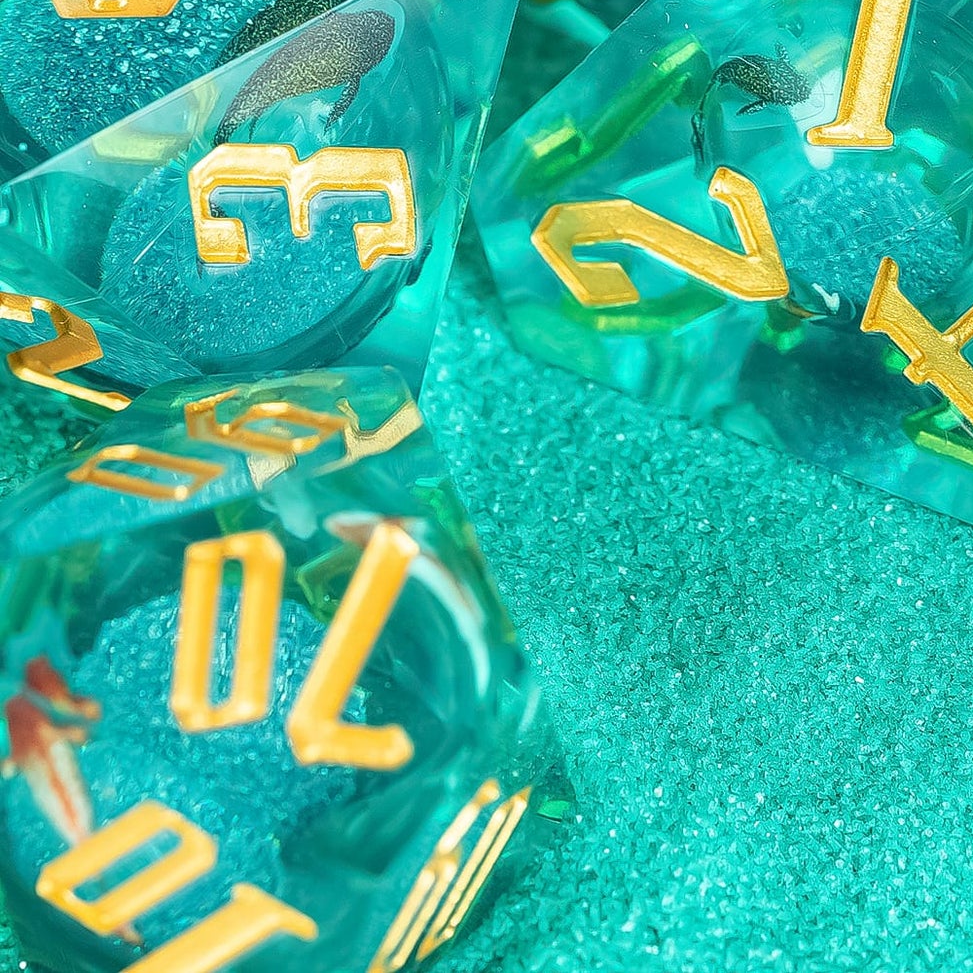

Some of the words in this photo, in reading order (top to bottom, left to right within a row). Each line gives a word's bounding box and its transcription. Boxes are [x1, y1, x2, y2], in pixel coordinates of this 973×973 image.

[187, 142, 418, 271] 3
[530, 165, 790, 308] 2
[168, 521, 417, 771] 70
